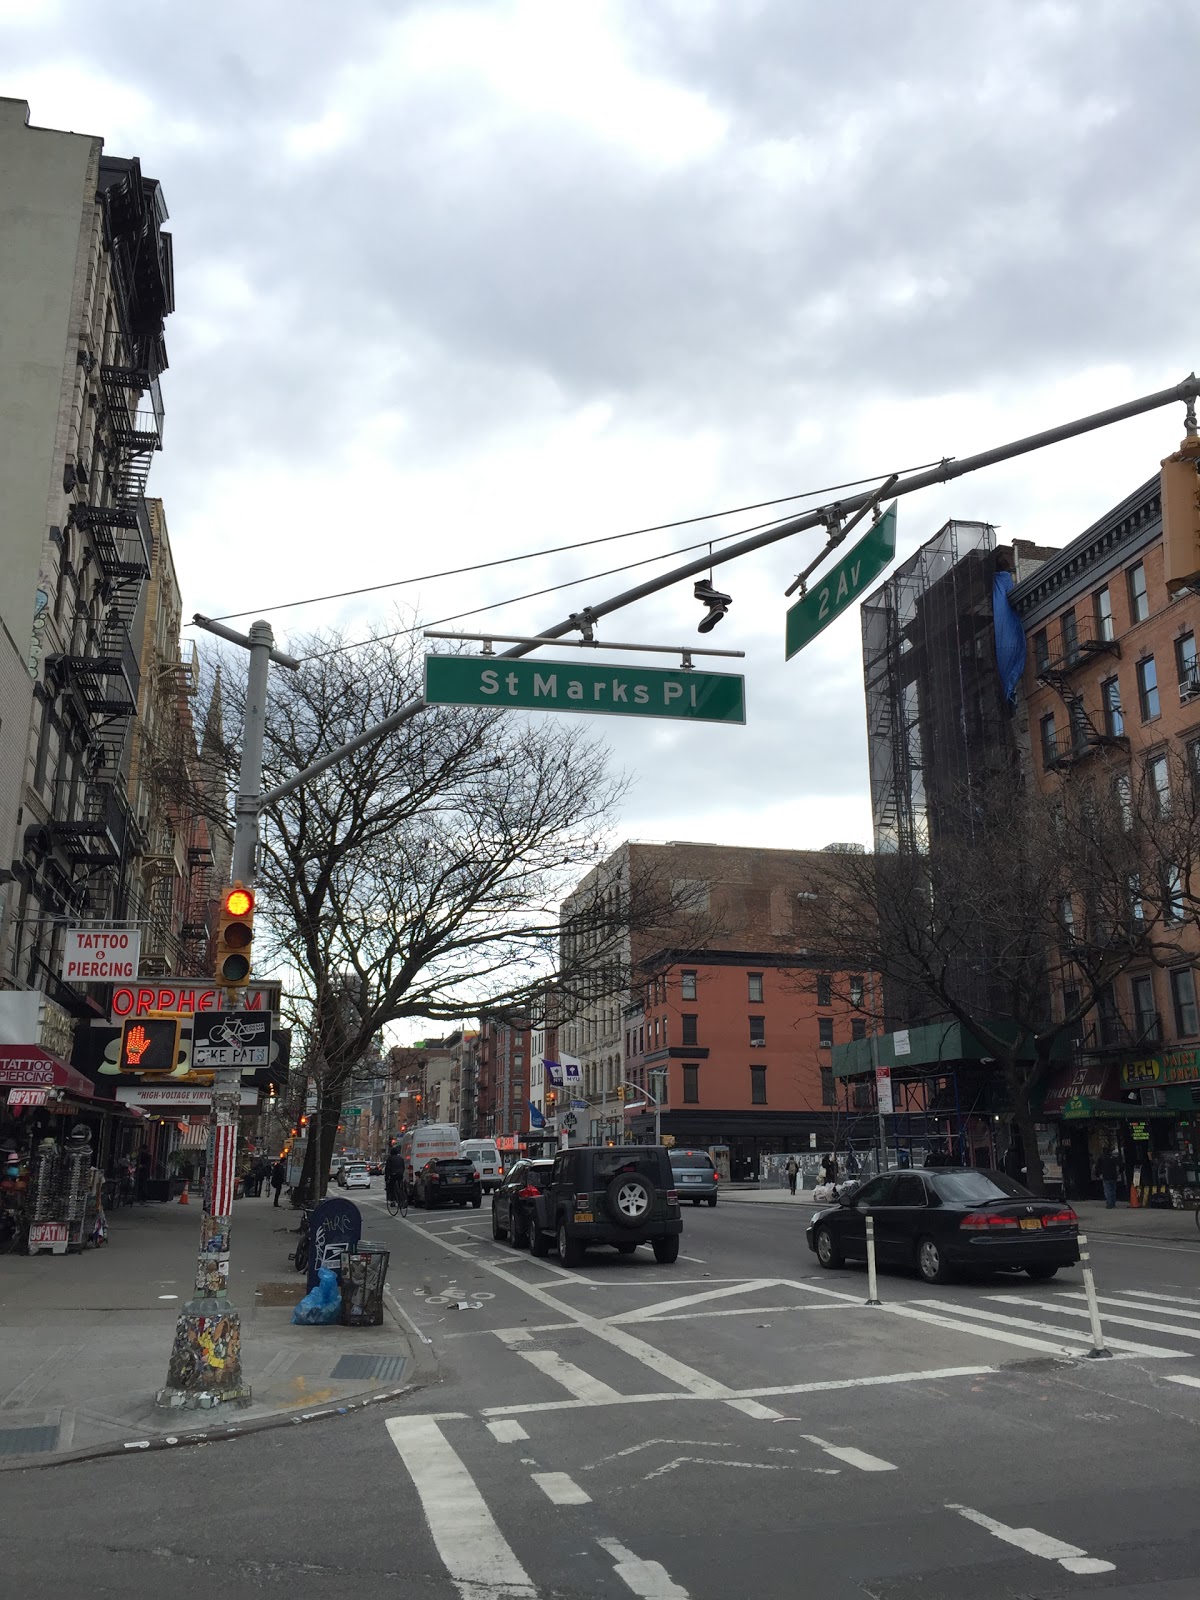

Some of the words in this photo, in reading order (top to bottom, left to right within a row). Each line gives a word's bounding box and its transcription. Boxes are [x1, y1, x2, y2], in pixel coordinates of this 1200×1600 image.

[818, 587, 830, 621] 2
[479, 669, 519, 696] St
[533, 672, 650, 704] Marks
[663, 681, 697, 708] Pl
[77, 933, 129, 950] TATTOO
[95, 950, 106, 961] &
[67, 961, 134, 977] PIERCING
[197, 1049, 227, 1063] BKE
[1162, 1051, 1197, 1069] DAIRY
[1, 1058, 53, 1071] TATTOO
[0, 1071, 54, 1083] PIERCING
[1162, 1065, 1200, 1082] LUNCH
